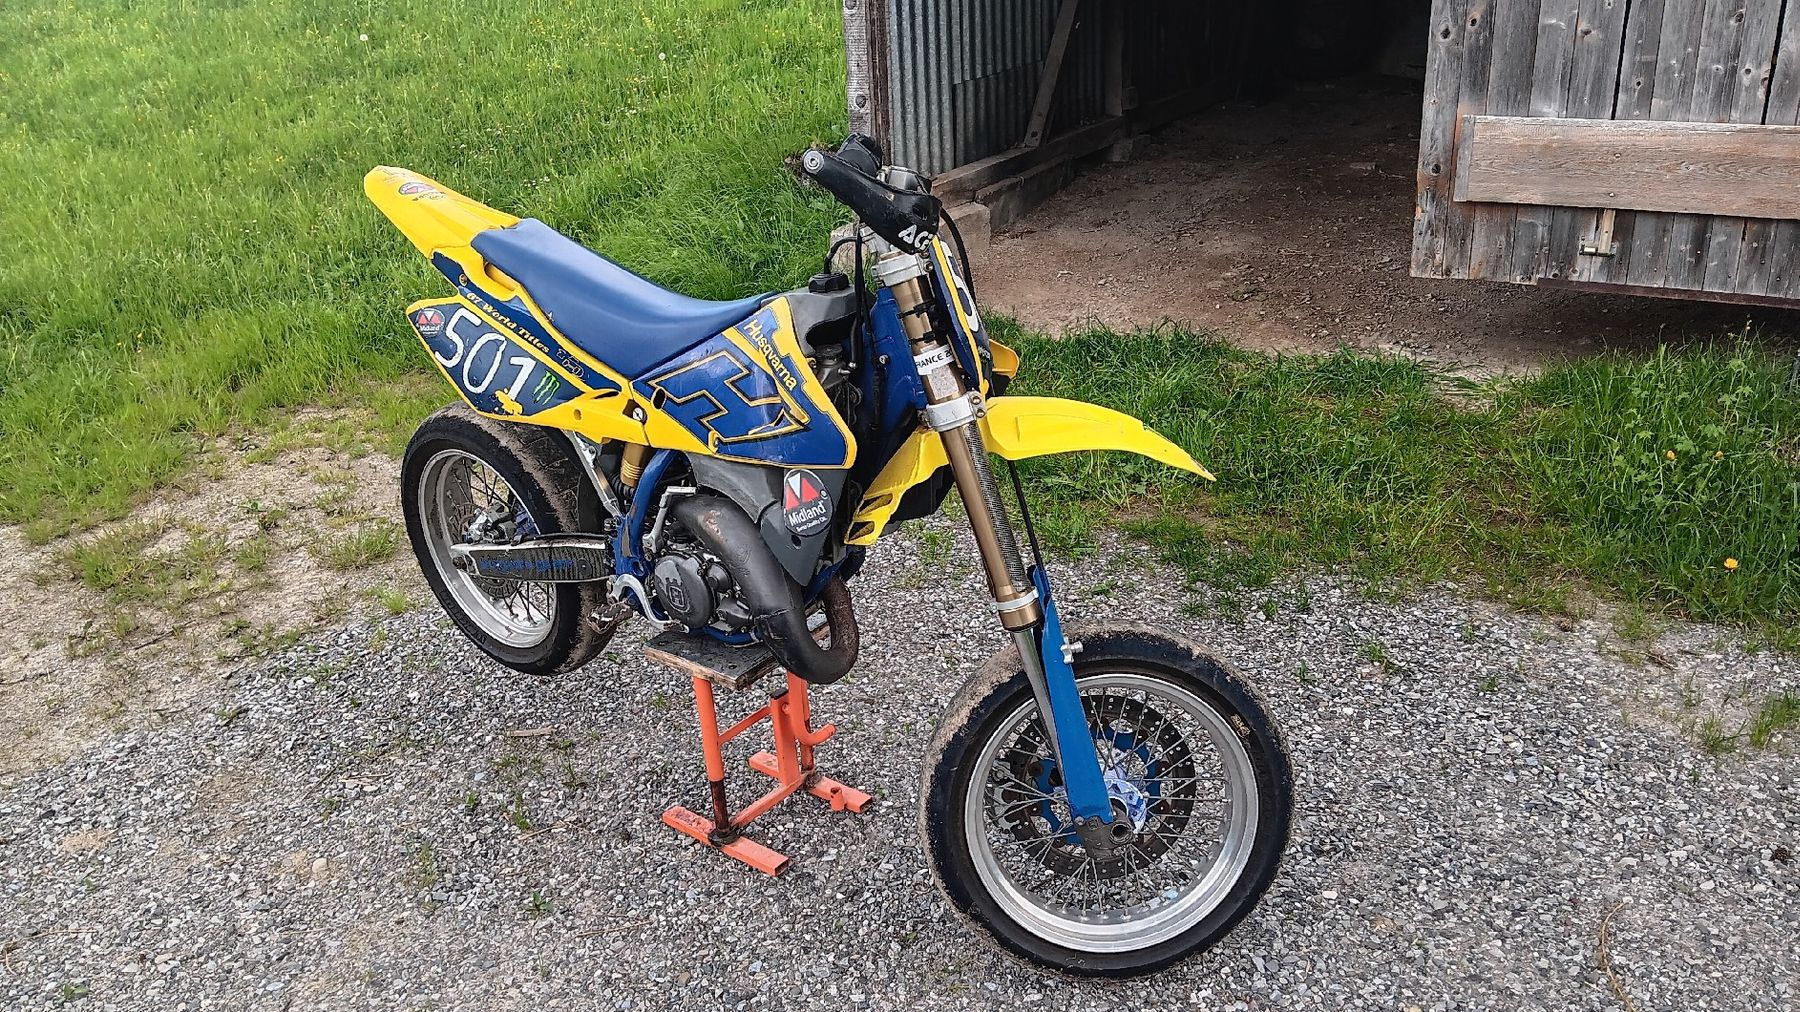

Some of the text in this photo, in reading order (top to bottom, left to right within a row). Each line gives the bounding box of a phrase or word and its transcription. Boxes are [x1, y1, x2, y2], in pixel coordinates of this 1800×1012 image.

[434, 307, 537, 401] 501
[482, 303, 517, 330] World
[519, 327, 550, 354] Titles
[743, 319, 797, 391] Husqvarna
[788, 501, 827, 526] Midland
